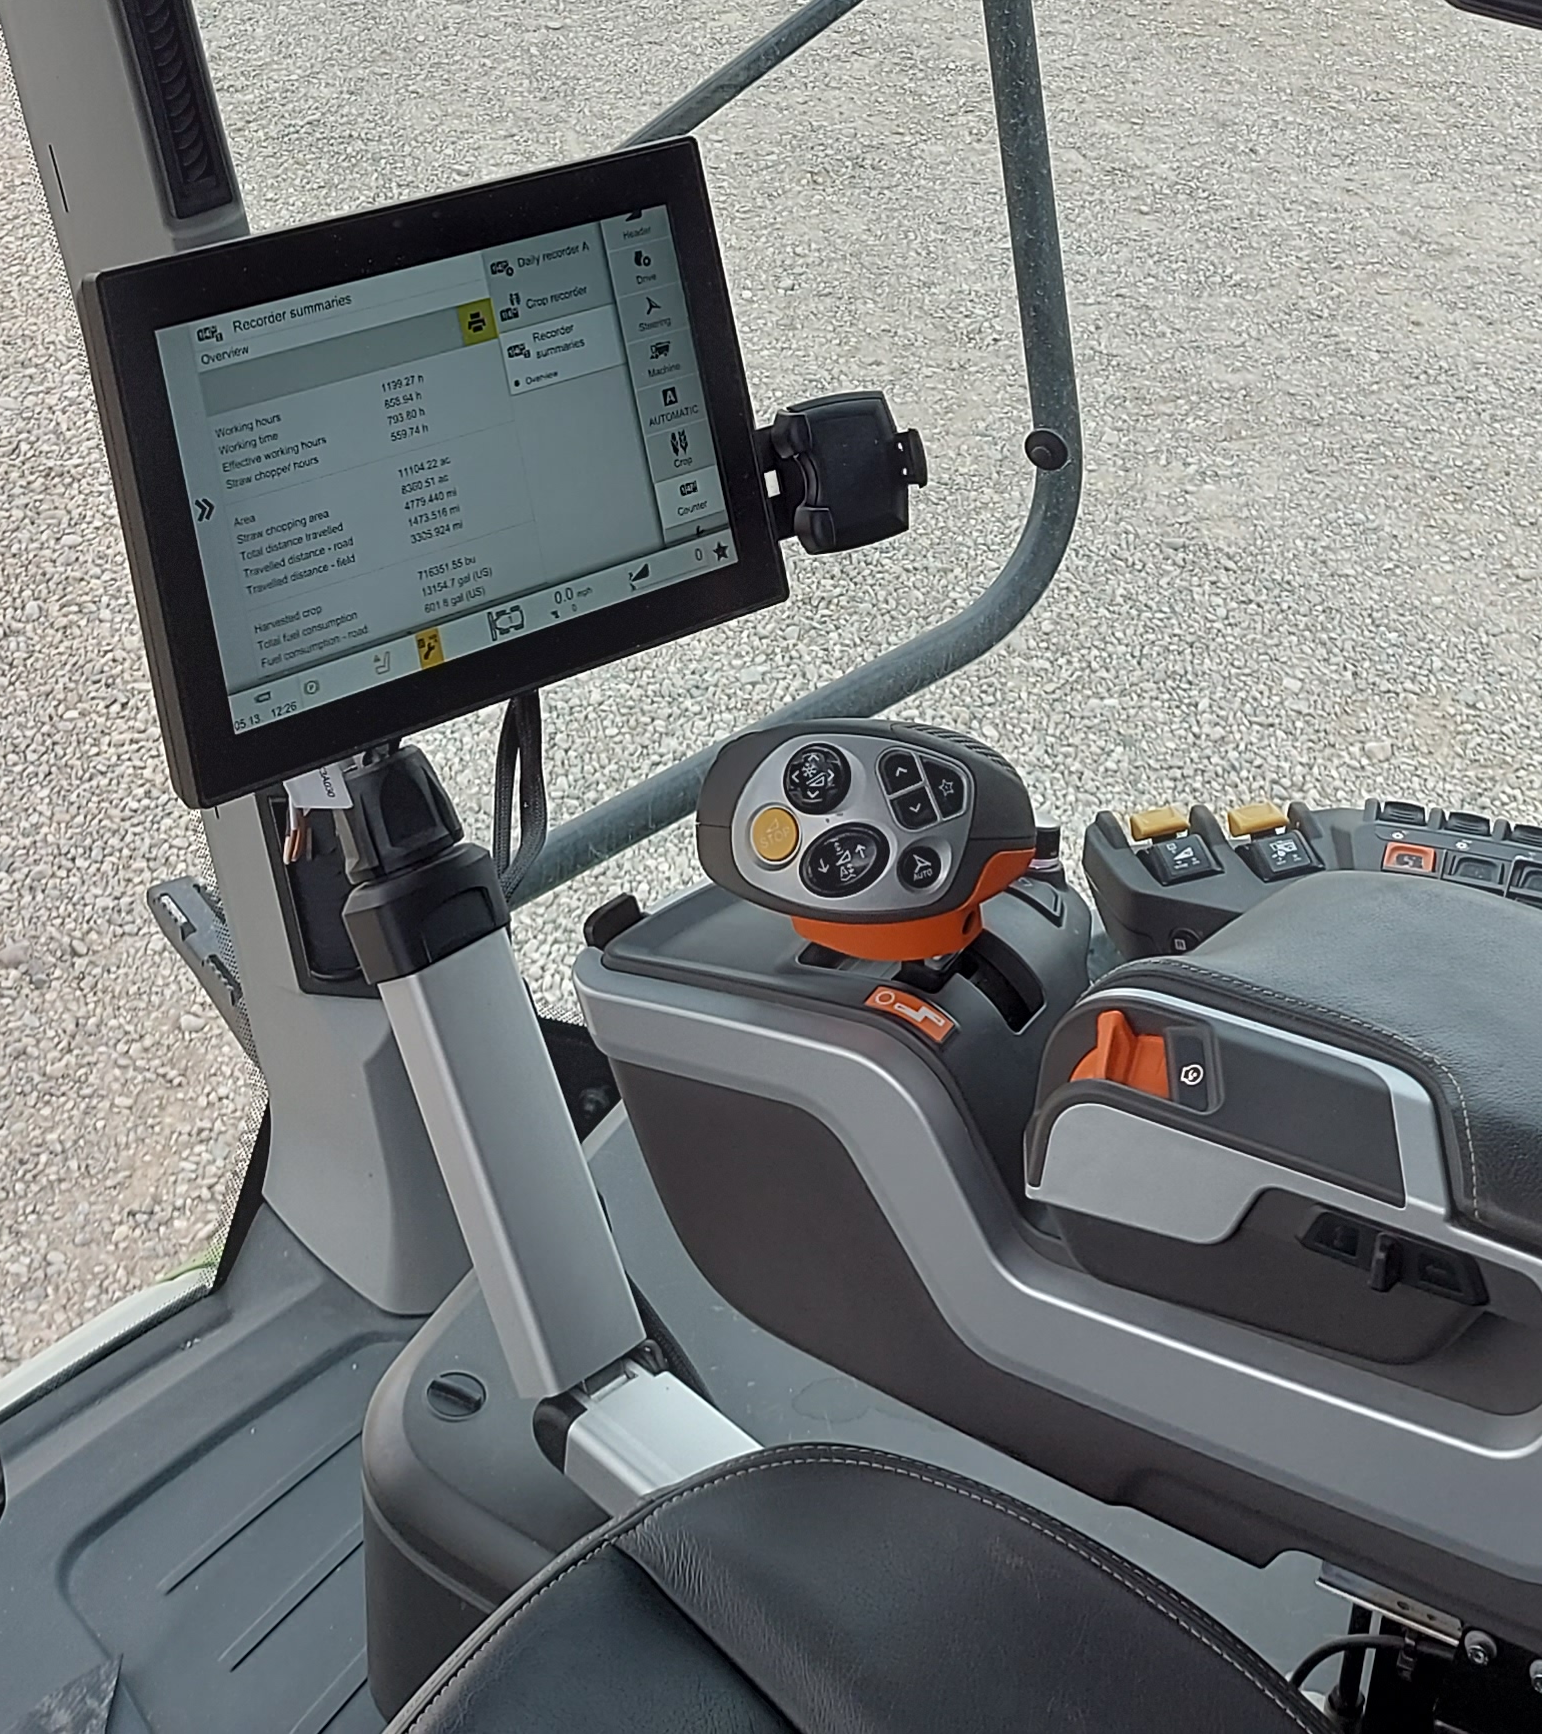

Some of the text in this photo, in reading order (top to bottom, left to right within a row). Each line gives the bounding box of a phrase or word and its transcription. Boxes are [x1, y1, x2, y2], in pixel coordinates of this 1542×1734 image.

[623, 226, 651, 241] Header
[517, 241, 590, 268] Daily recorder A
[635, 273, 657, 285] Drive
[526, 285, 587, 309] Crop recorder
[232, 294, 352, 333] Recorder summaries
[532, 324, 574, 343] Recorder
[638, 317, 671, 333] Steering
[201, 346, 249, 365] Overview
[536, 338, 586, 360] summaries
[525, 370, 559, 385] Overview
[647, 363, 681, 378] Machine
[215, 414, 281, 438] Working hours
[649, 404, 699, 427] AUTOMATIC
[218, 433, 278, 455] Working time
[222, 456, 261, 472] Effective
[264, 445, 299, 460] working
[301, 437, 327, 450] hours
[226, 476, 252, 489] Straw
[255, 463, 290, 481] chopper
[293, 457, 319, 471] hours
[673, 456, 693, 468] Crop
[677, 500, 708, 517] Counter
[234, 515, 256, 527] Area
[237, 510, 330, 544] Straw chopping area
[240, 547, 264, 561] Total
[266, 536, 303, 553] distance
[305, 522, 344, 542] travelled
[404, 491, 445, 510] 4779.440
[243, 558, 286, 578] Travelled
[288, 547, 325, 565] distance
[333, 536, 354, 551] road
[408, 507, 448, 527] 1473.516
[695, 548, 703, 561] 0
[246, 574, 289, 595] Travelled
[290, 563, 329, 582] distance
[336, 553, 356, 568] field
[254, 611, 300, 634] Harvested
[302, 605, 323, 618] crop
[464, 556, 476, 566] bu
[554, 586, 593, 605] 0.0 mph
[257, 637, 281, 651] Total
[283, 629, 300, 643] fuel
[302, 611, 358, 636] consumption
[457, 573, 470, 587] gal
[473, 567, 493, 582] (US)
[260, 586, 486, 667] Fuel consumption road gal (US)
[759, 826, 791, 849] STOP
[913, 868, 934, 882] AUTO
